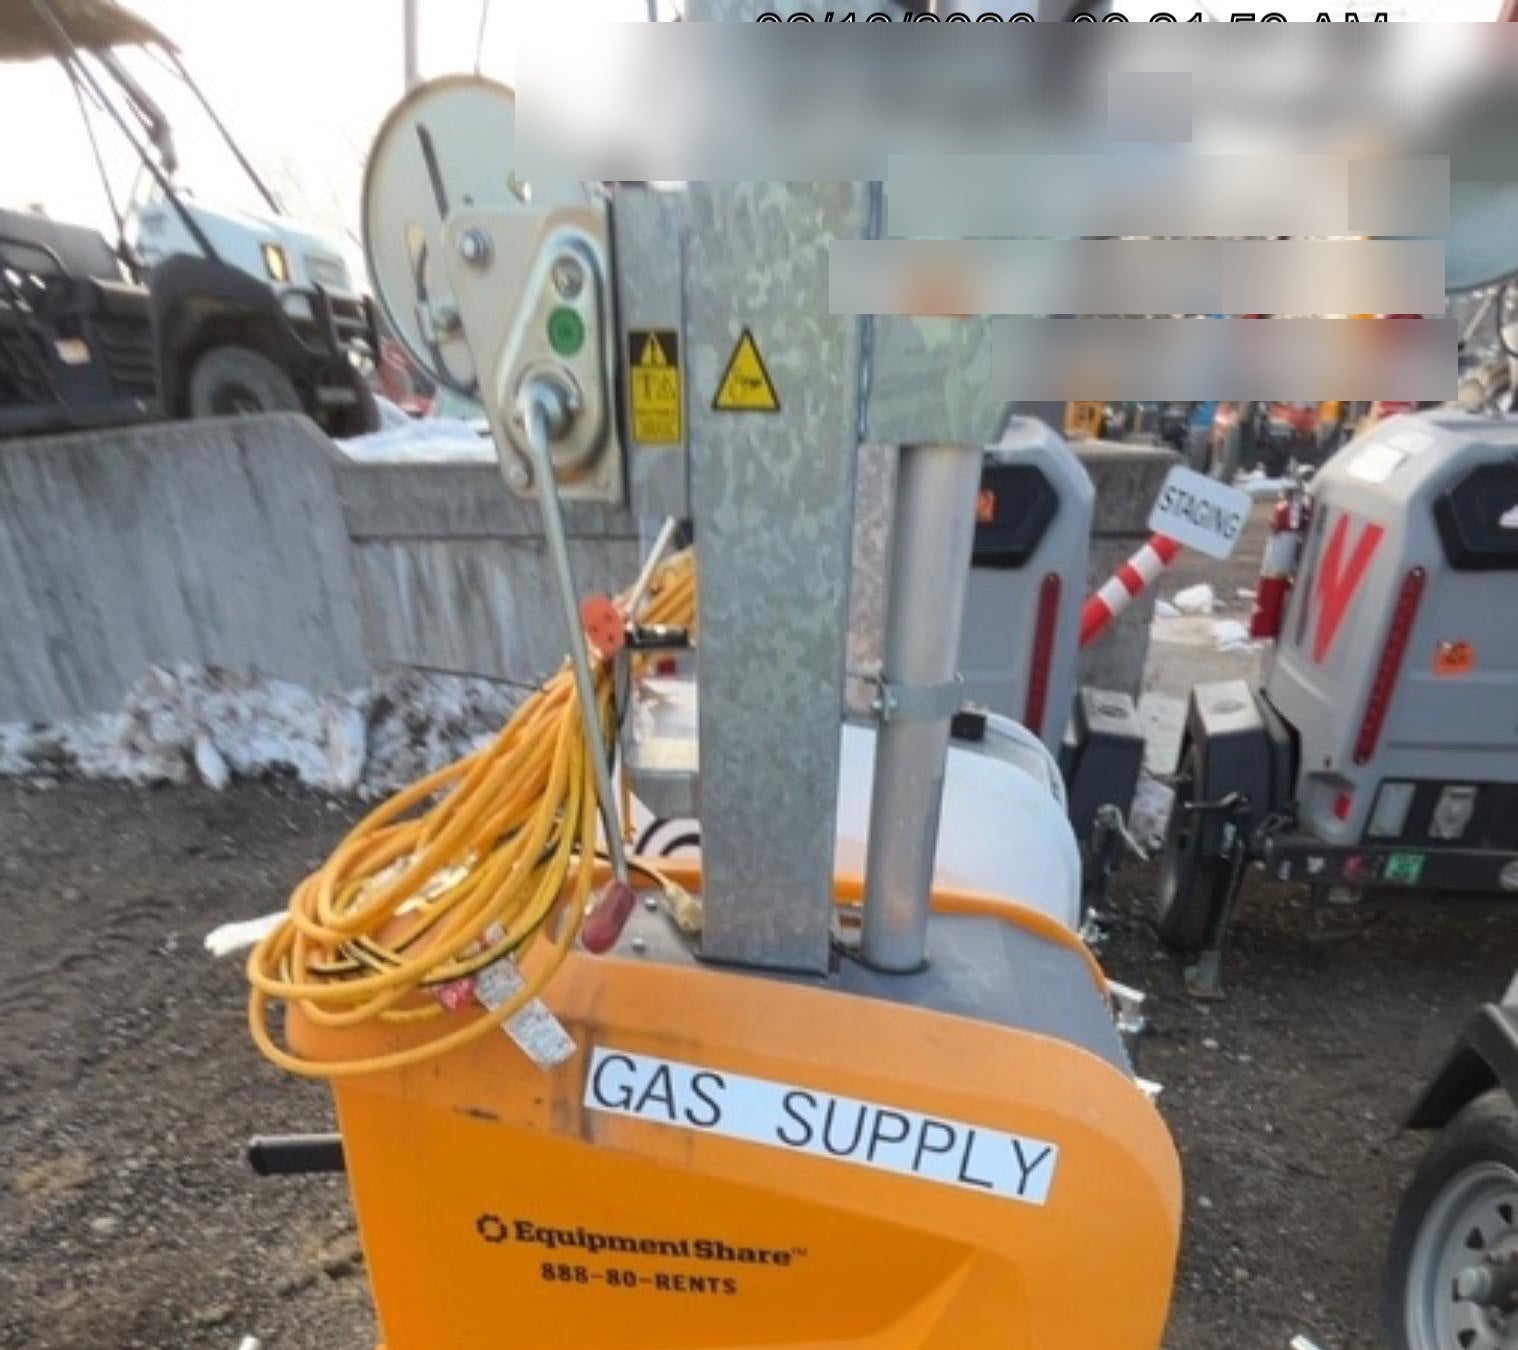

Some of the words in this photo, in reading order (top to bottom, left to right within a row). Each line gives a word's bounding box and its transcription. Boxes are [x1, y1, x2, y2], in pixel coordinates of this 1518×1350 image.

[1160, 486, 1240, 539] STAGING
[592, 1054, 725, 1127] GAS
[776, 1091, 1051, 1195] SUPPLY
[541, 1262, 738, 1294] 888-80-RENTS
